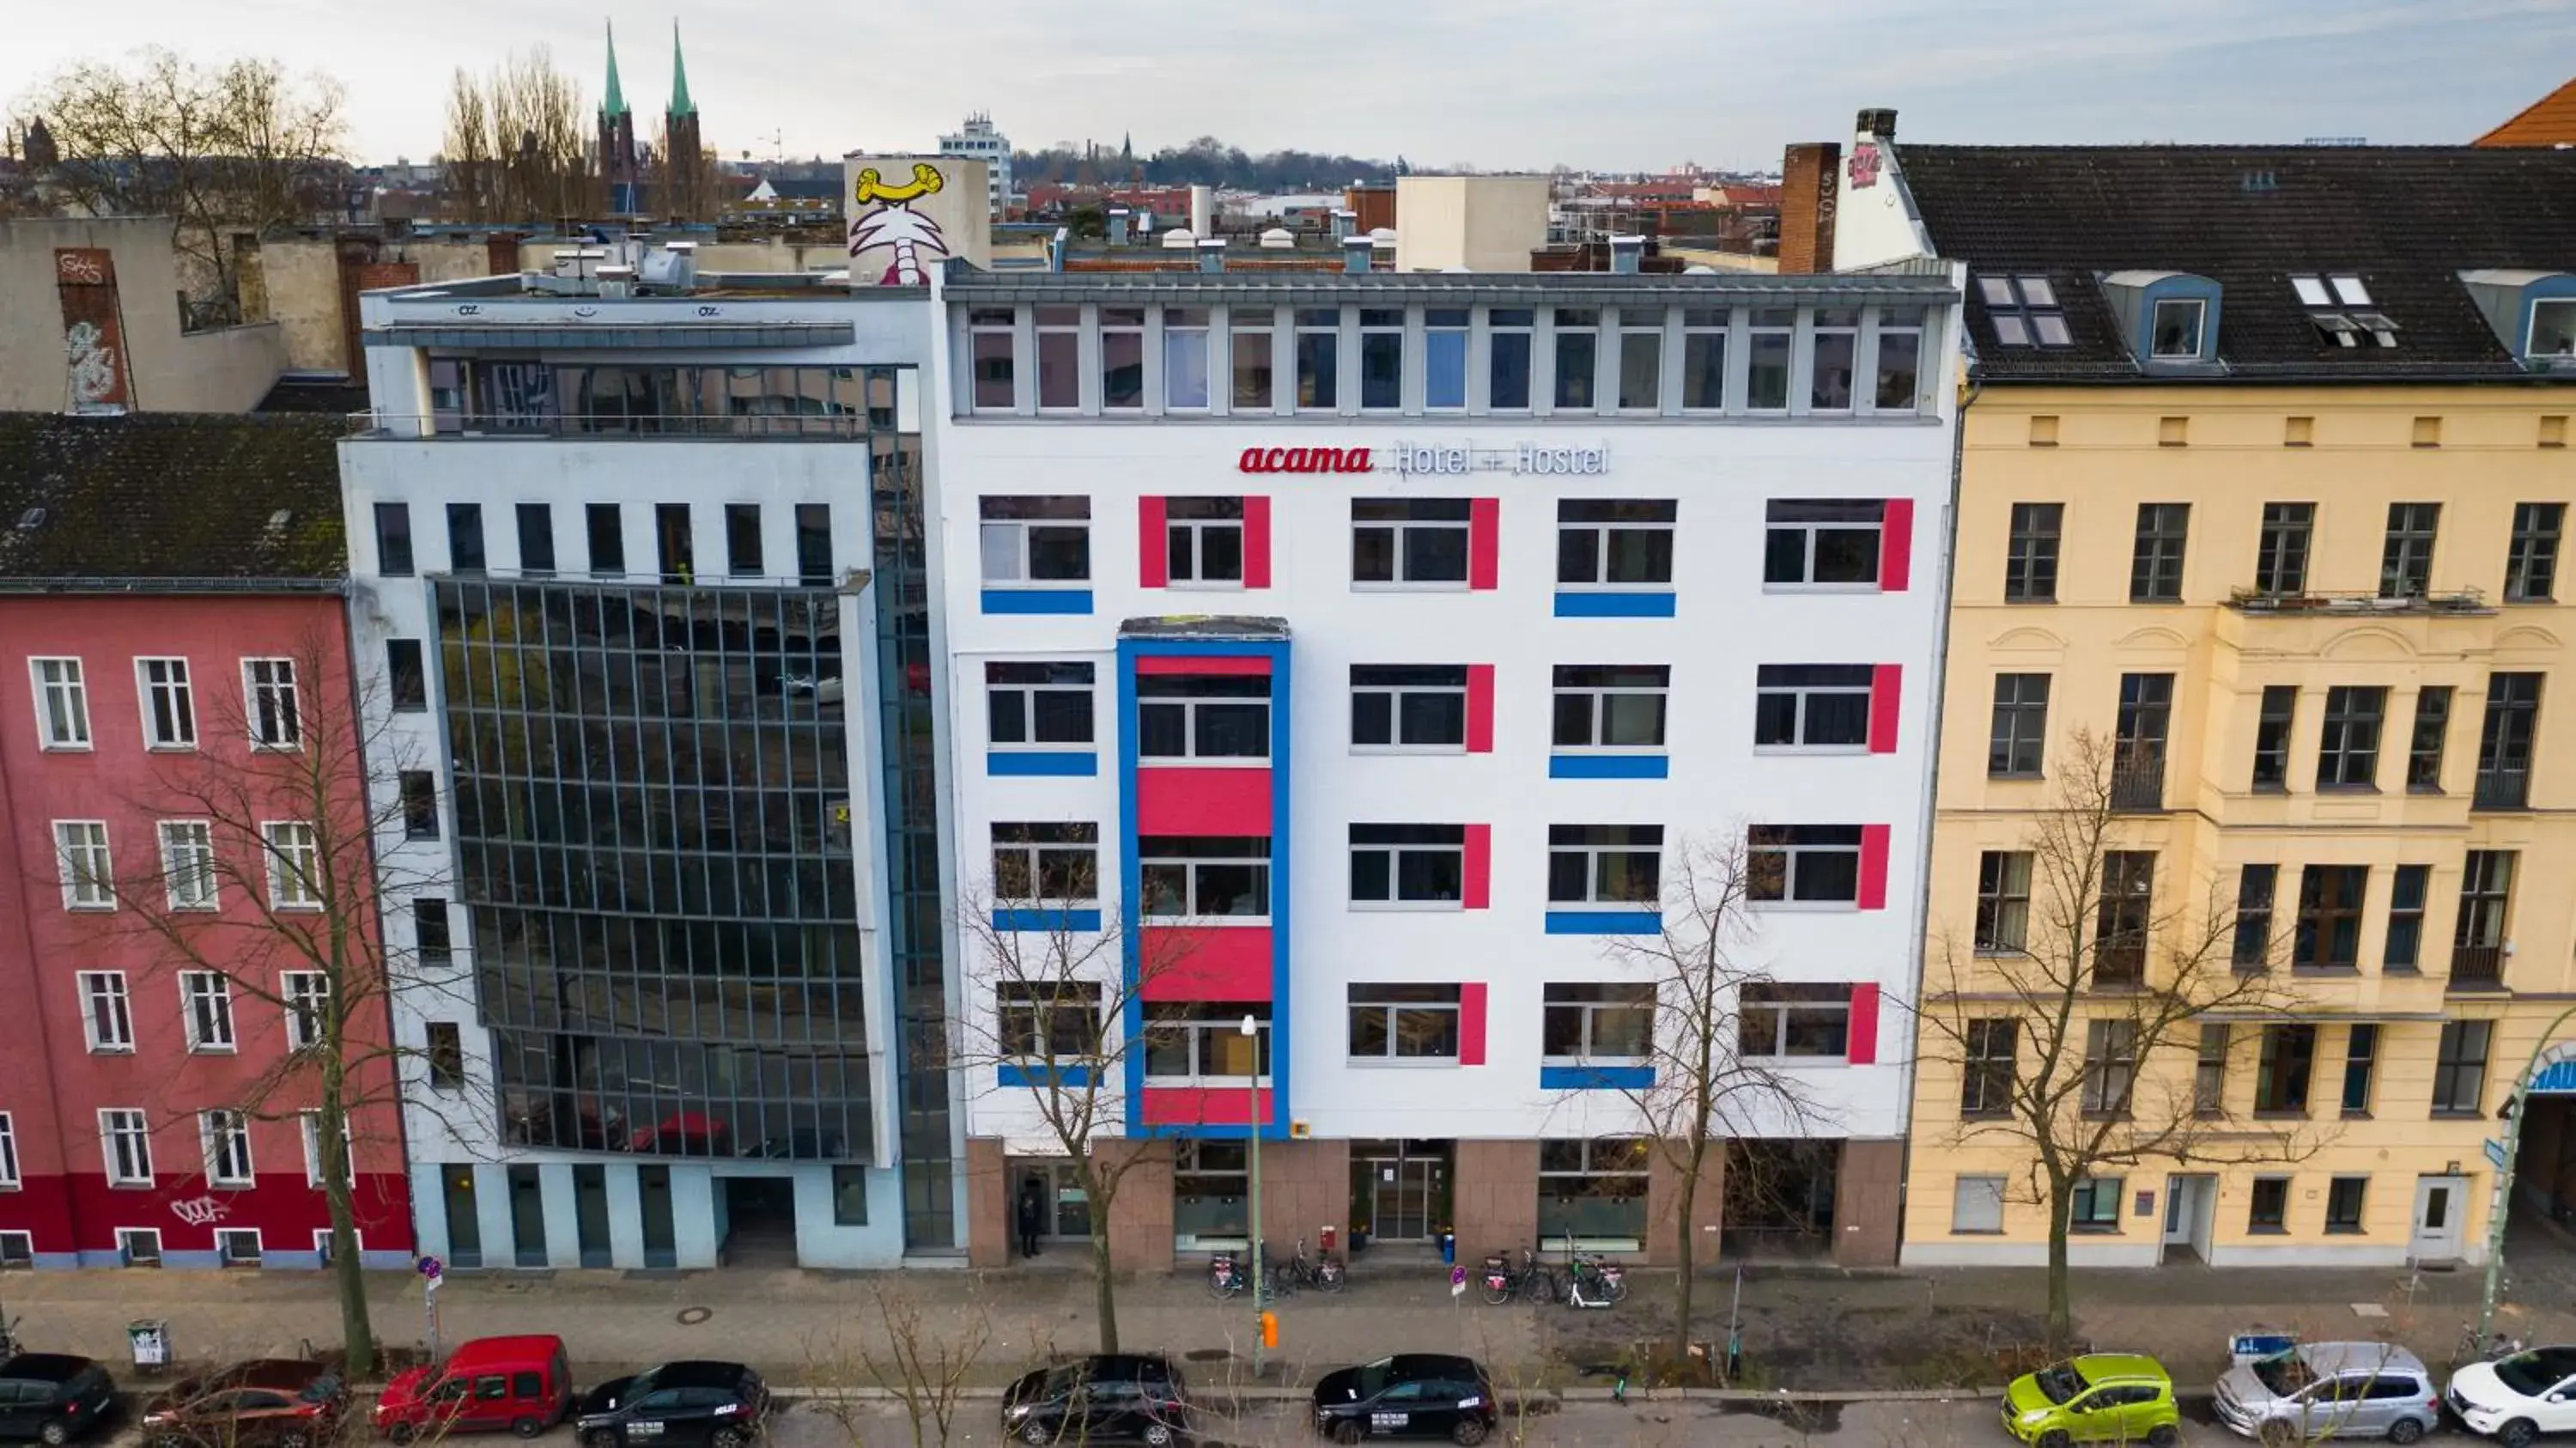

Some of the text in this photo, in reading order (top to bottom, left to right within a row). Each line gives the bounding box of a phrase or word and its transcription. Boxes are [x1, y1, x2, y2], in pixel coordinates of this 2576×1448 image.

[1239, 447, 1374, 473] acama
[1394, 441, 1472, 473] Hotel
[1516, 441, 1608, 474] Hostel
